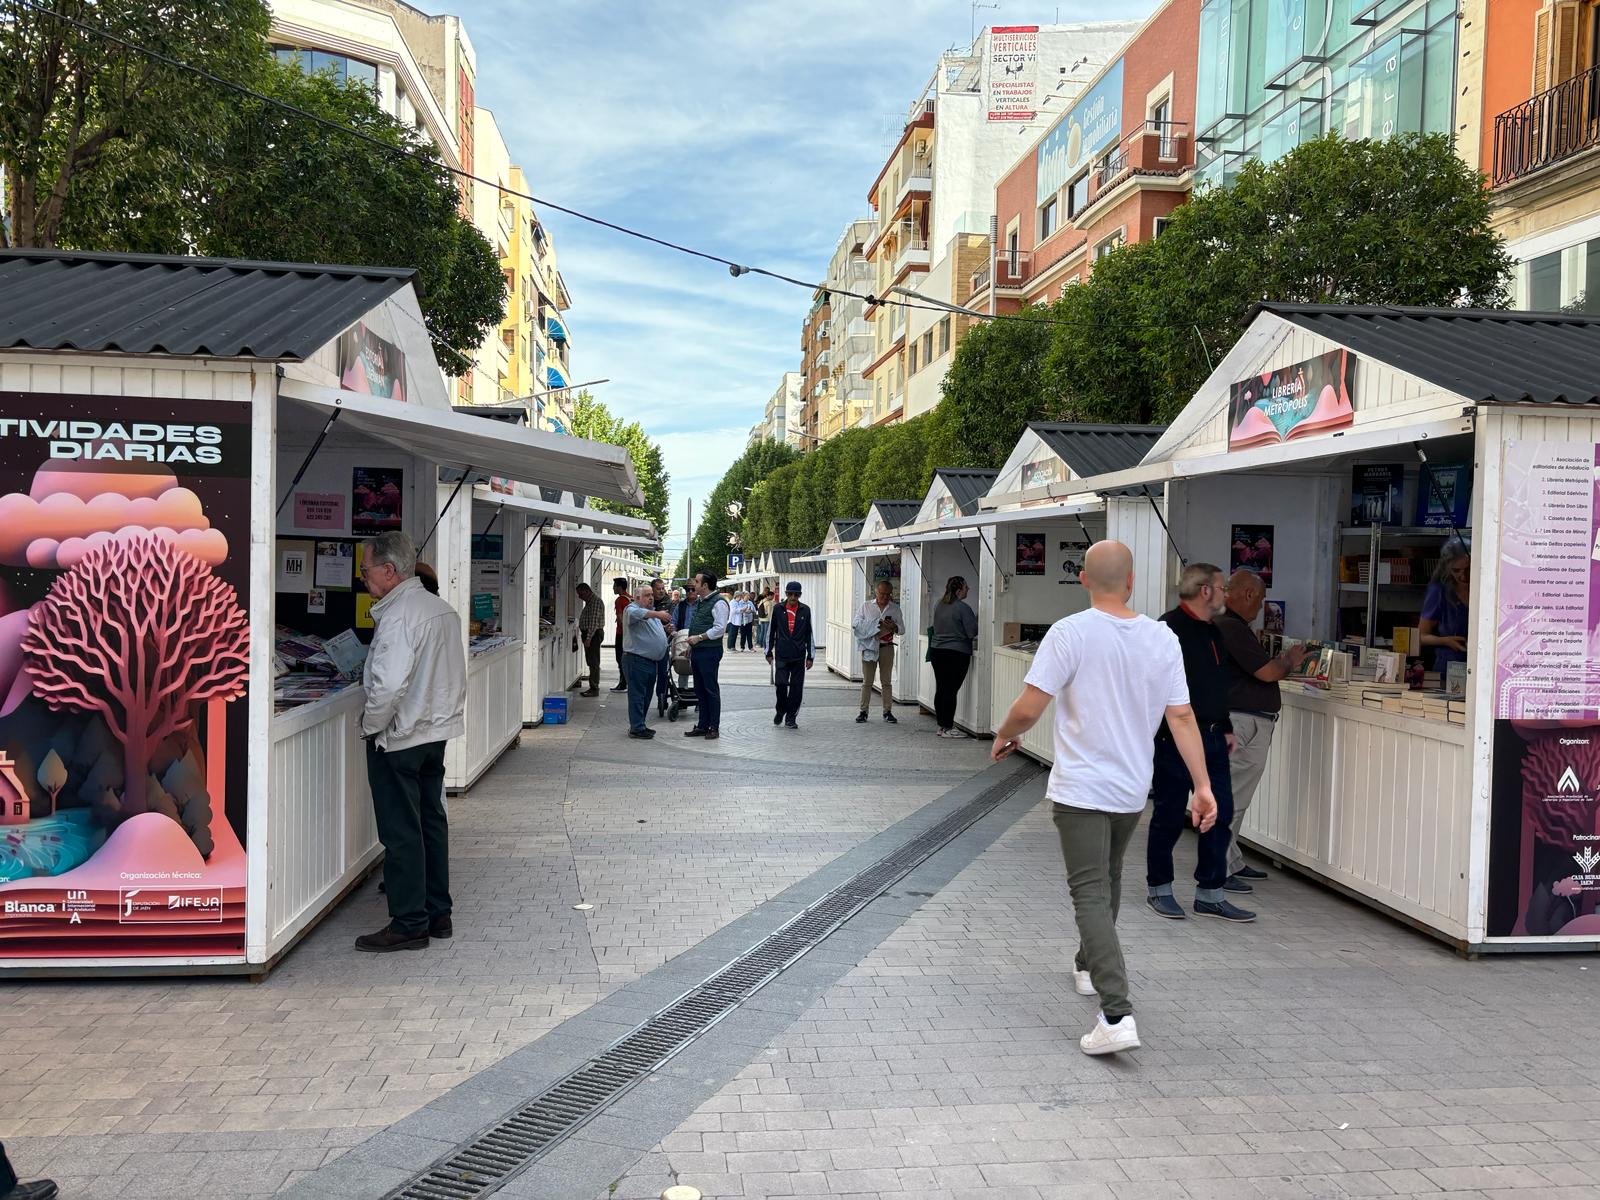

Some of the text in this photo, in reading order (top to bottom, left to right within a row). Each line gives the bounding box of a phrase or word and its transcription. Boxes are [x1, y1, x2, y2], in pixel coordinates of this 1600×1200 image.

[993, 33, 1036, 41] MULTISERVICIOS
[993, 42, 1036, 52] VERTICALES
[993, 54, 1025, 62] SECTOR
[50, 440, 222, 464] DIARIAS
[286, 560, 302, 572] MH
[732, 556, 739, 566] P
[120, 871, 202, 880] Organización técnica:
[4, 900, 55, 913] Blanca
[181, 897, 219, 907] IFEJA
